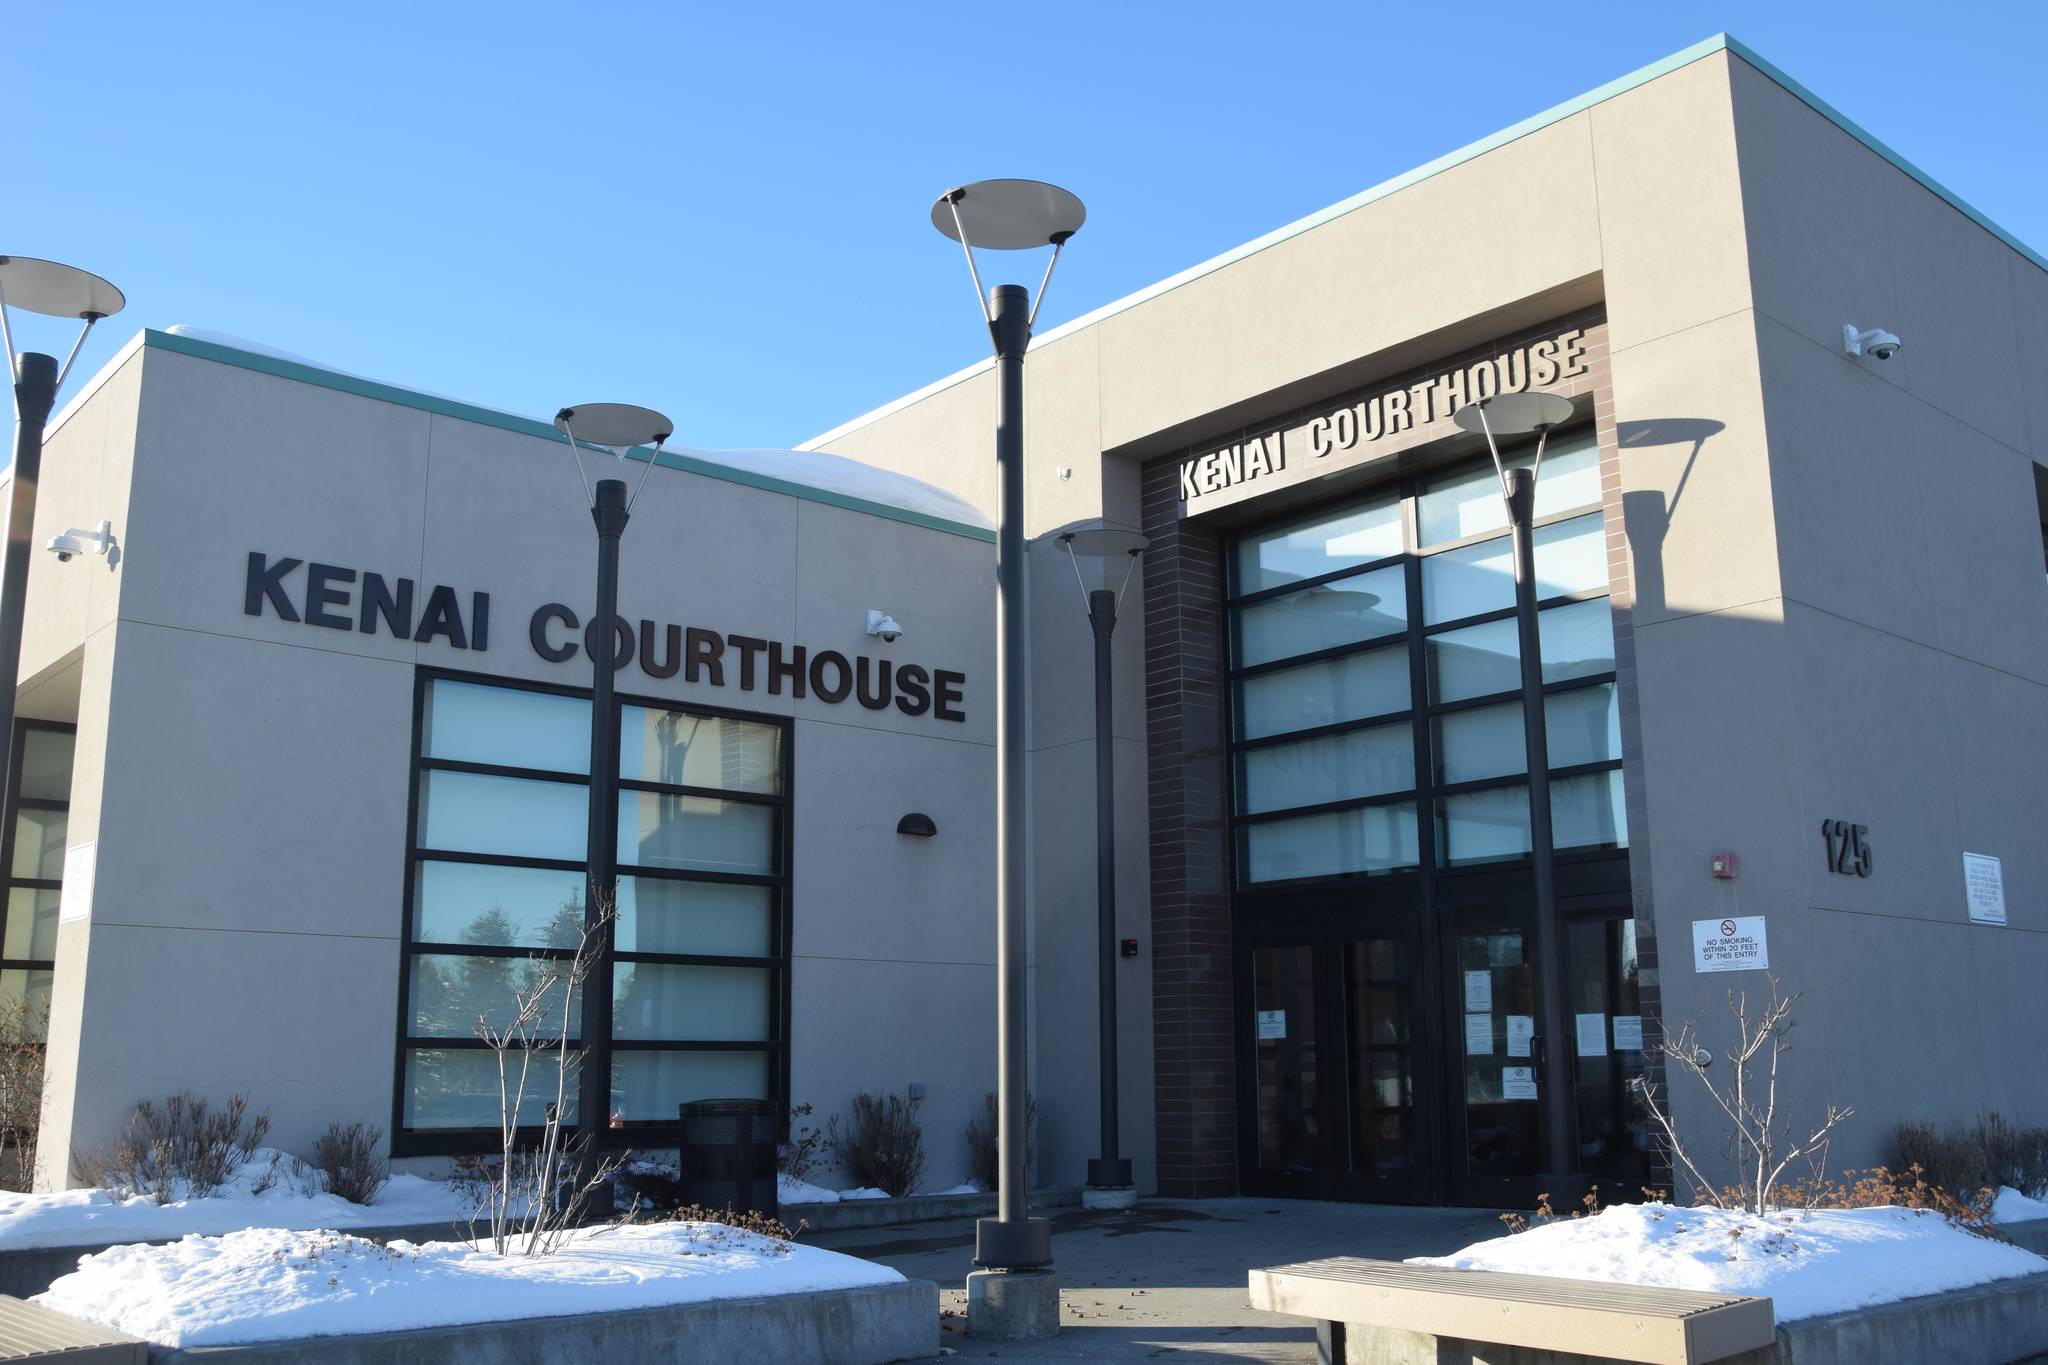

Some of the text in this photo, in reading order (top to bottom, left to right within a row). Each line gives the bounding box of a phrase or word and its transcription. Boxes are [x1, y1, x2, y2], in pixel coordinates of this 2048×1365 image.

[1180, 329, 1586, 501] KENAI COURTHOUSE
[245, 551, 966, 723] KENAI COURTHOUSE
[1822, 819, 1873, 878] 125
[1702, 943, 1759, 953] WITHIN 20 FEET
[1716, 952, 1732, 960] THIS
[1734, 950, 1758, 959] ENTRY
[1720, 936, 1753, 945] SMOKING
